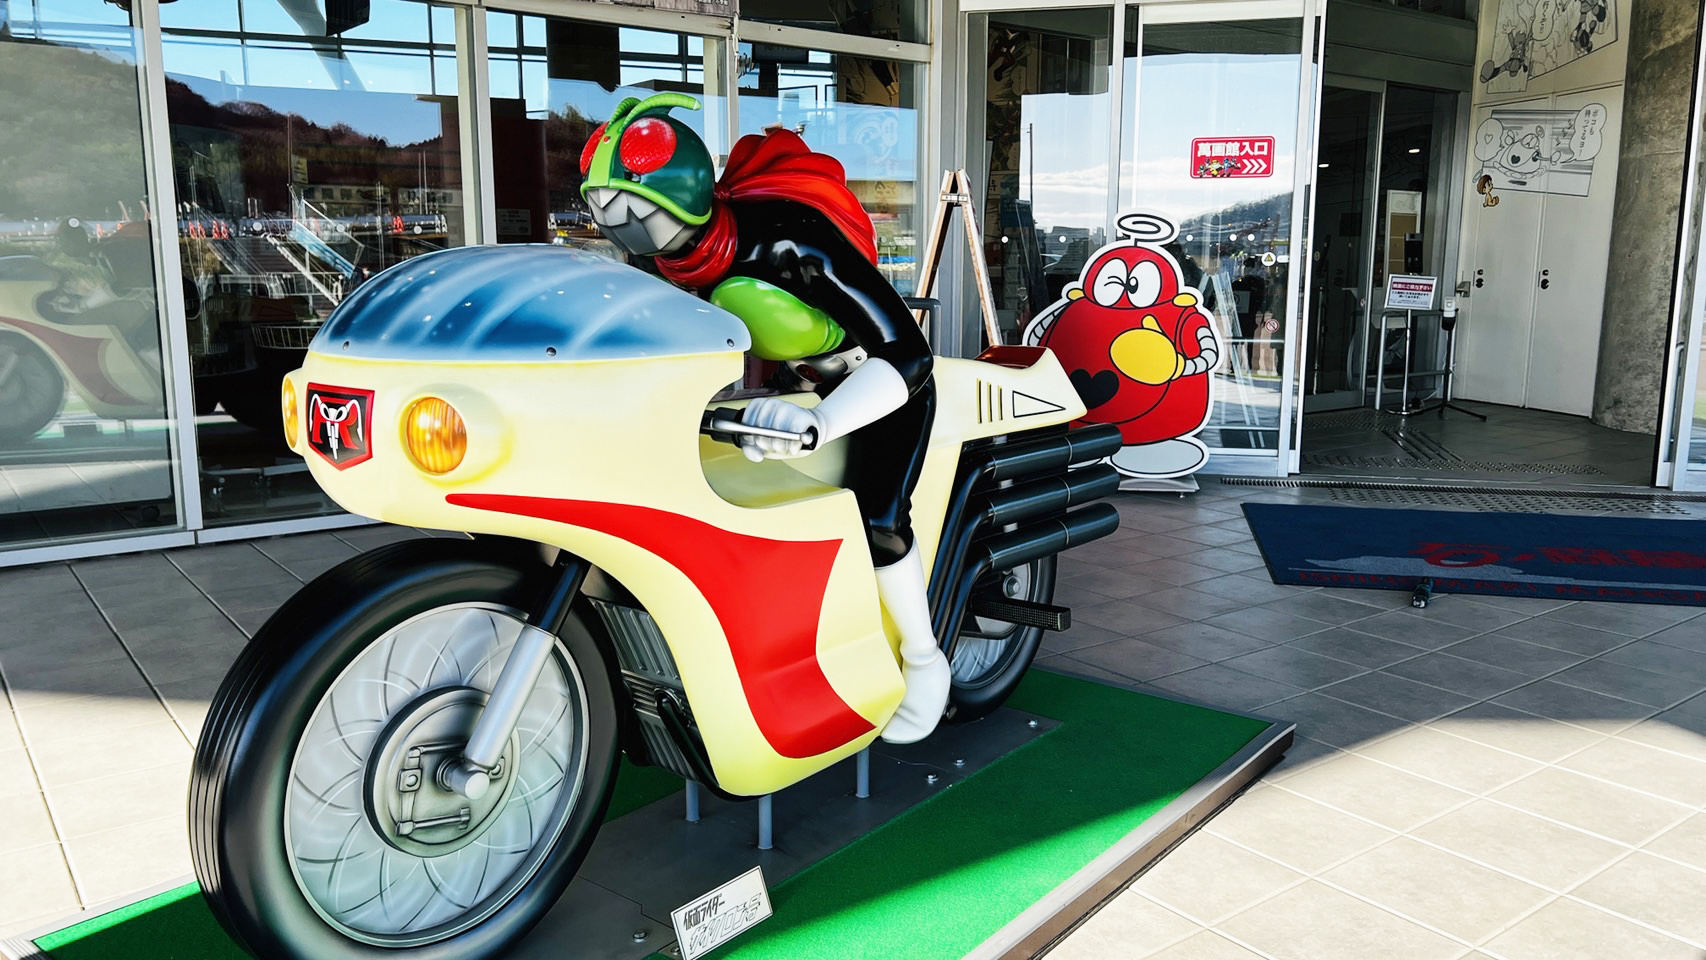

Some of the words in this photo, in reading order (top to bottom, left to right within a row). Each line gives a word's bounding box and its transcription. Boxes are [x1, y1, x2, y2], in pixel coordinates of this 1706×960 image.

[1197, 141, 1269, 157] 萬画館入口
